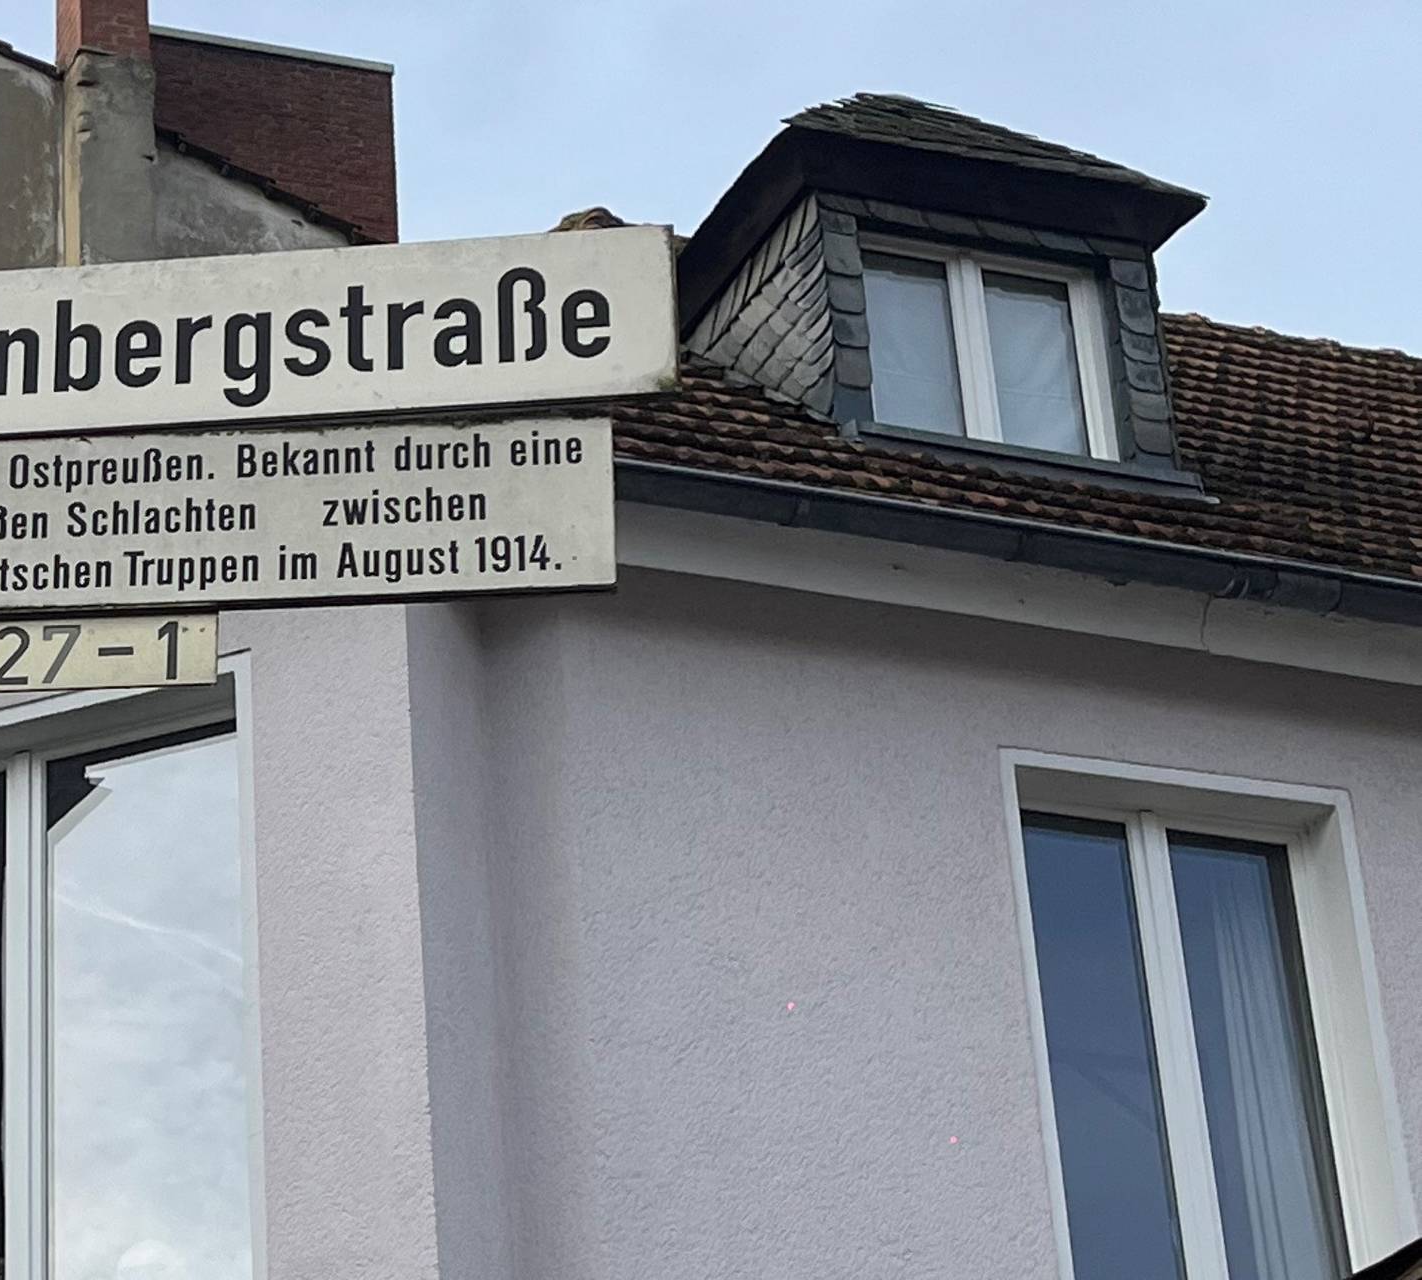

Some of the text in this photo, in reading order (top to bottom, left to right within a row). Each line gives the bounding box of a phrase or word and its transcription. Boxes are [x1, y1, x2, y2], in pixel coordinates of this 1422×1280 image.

[10, 448, 214, 493] Ostpreußen.
[237, 441, 374, 478] Bekannt
[395, 433, 490, 471] durch
[511, 431, 581, 466] eine
[68, 498, 255, 537] Schlachten
[323, 487, 485, 526] zwischen
[124, 551, 258, 591] Truppen
[279, 545, 316, 580] im
[337, 541, 458, 582] August
[475, 535, 561, 572] 1914.
